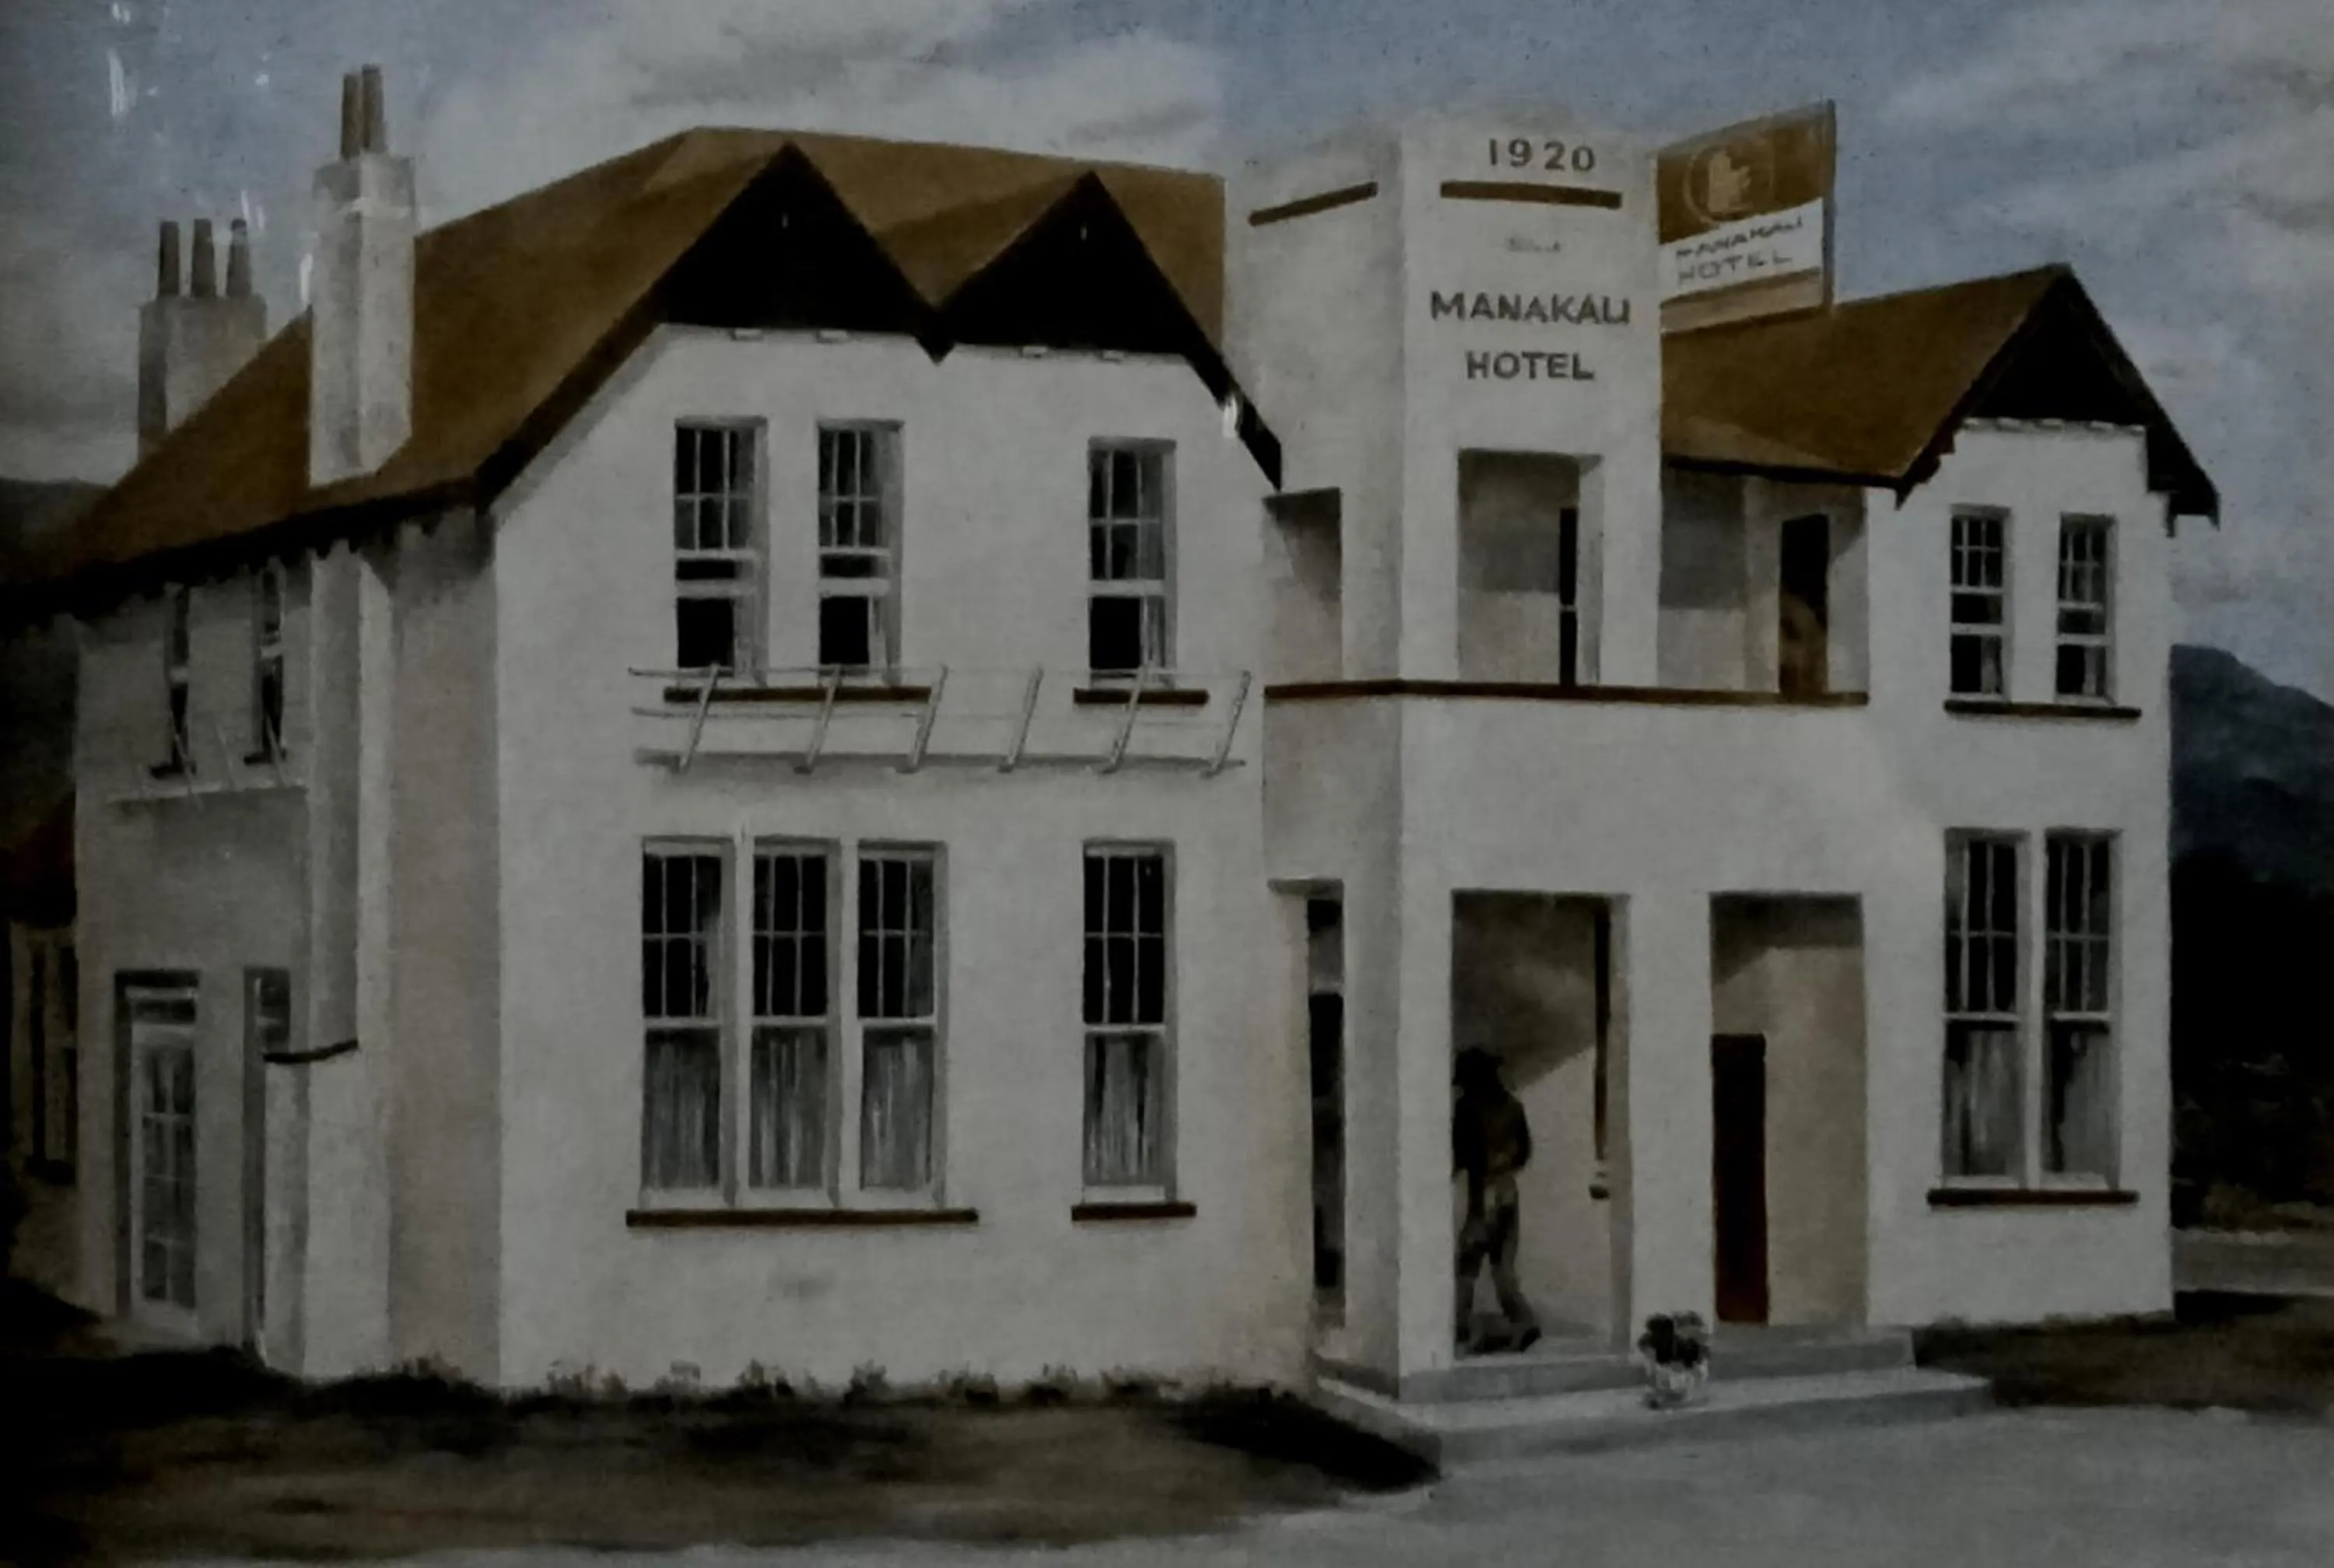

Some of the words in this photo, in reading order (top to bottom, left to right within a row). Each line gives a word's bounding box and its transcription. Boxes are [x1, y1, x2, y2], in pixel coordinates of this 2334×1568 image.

[1488, 138, 1596, 172] 1920
[1677, 249, 1793, 285] HOTEL
[1431, 290, 1630, 324] MANAKAU
[1466, 351, 1595, 380] HOTEL
